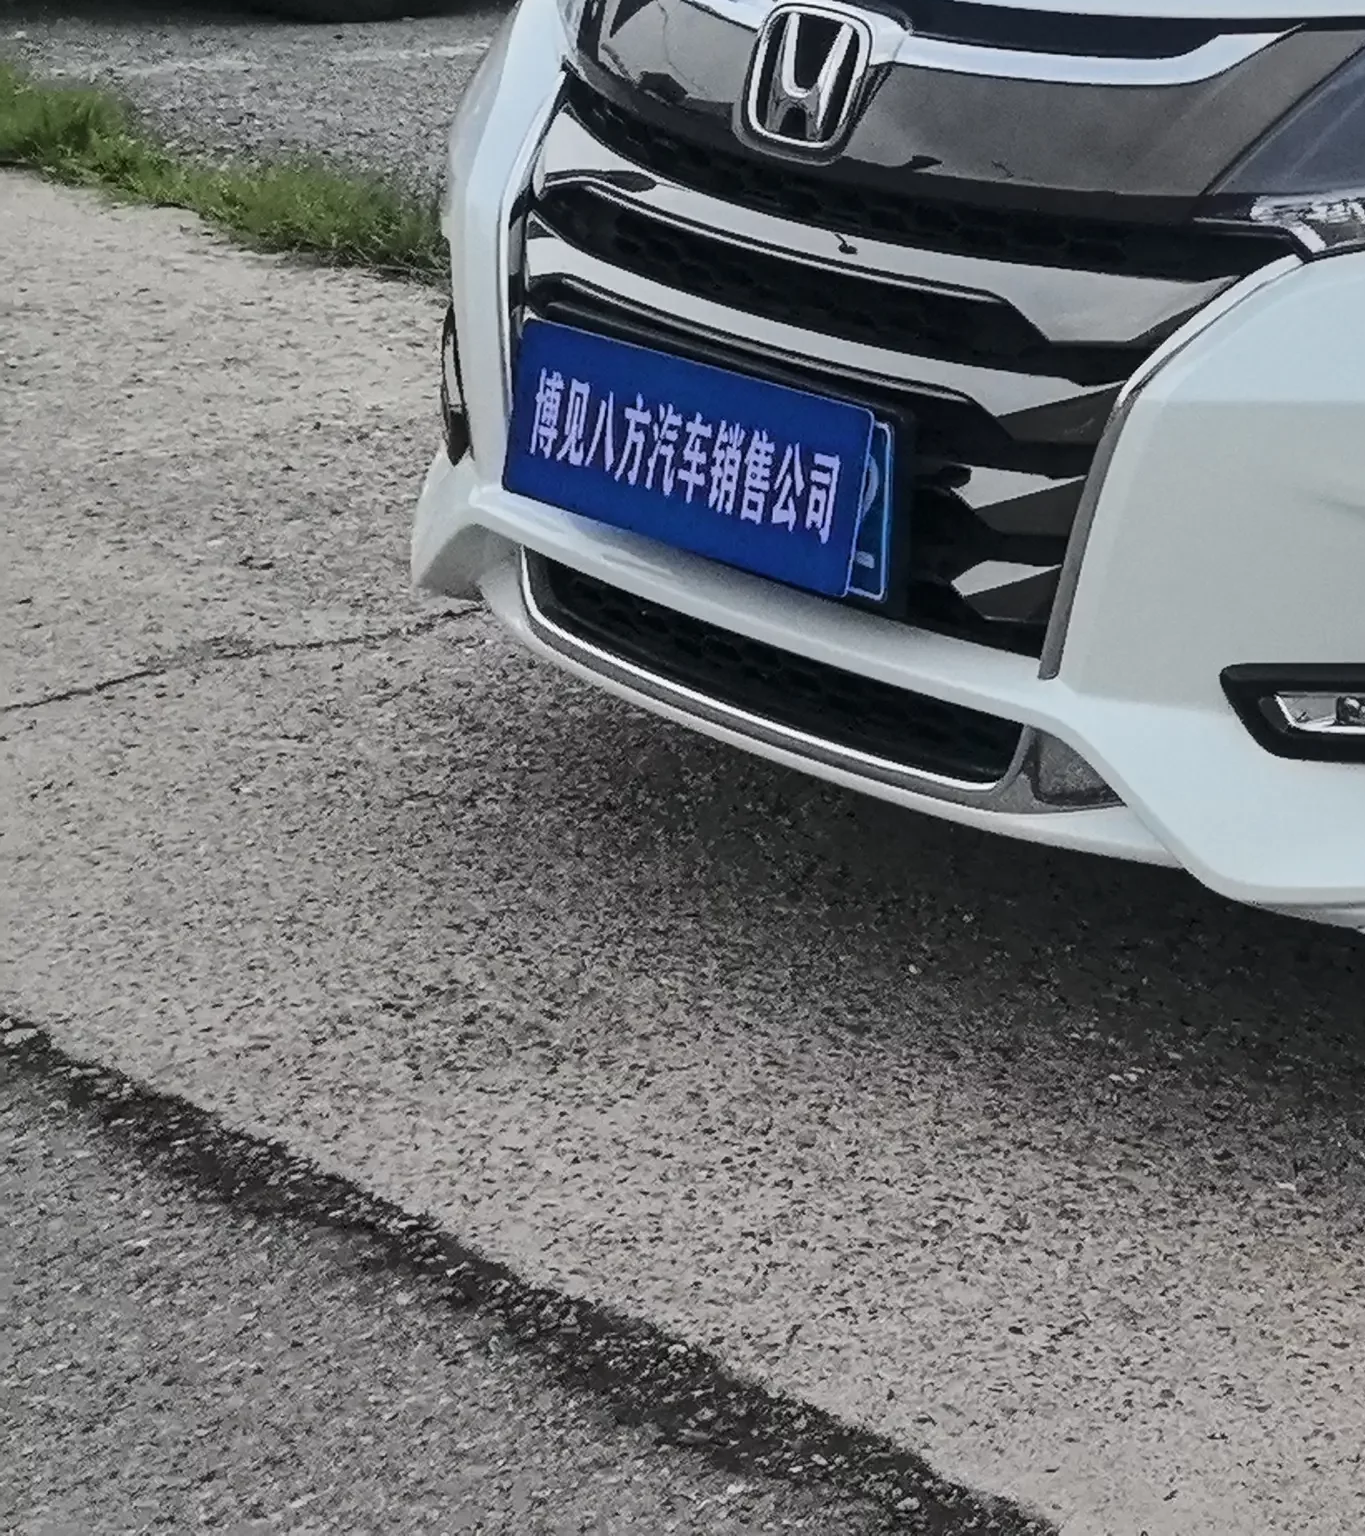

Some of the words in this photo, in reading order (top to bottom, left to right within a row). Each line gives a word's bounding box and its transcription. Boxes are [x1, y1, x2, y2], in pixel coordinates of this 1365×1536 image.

[531, 367, 841, 543] 博见八方汽车销售公司
